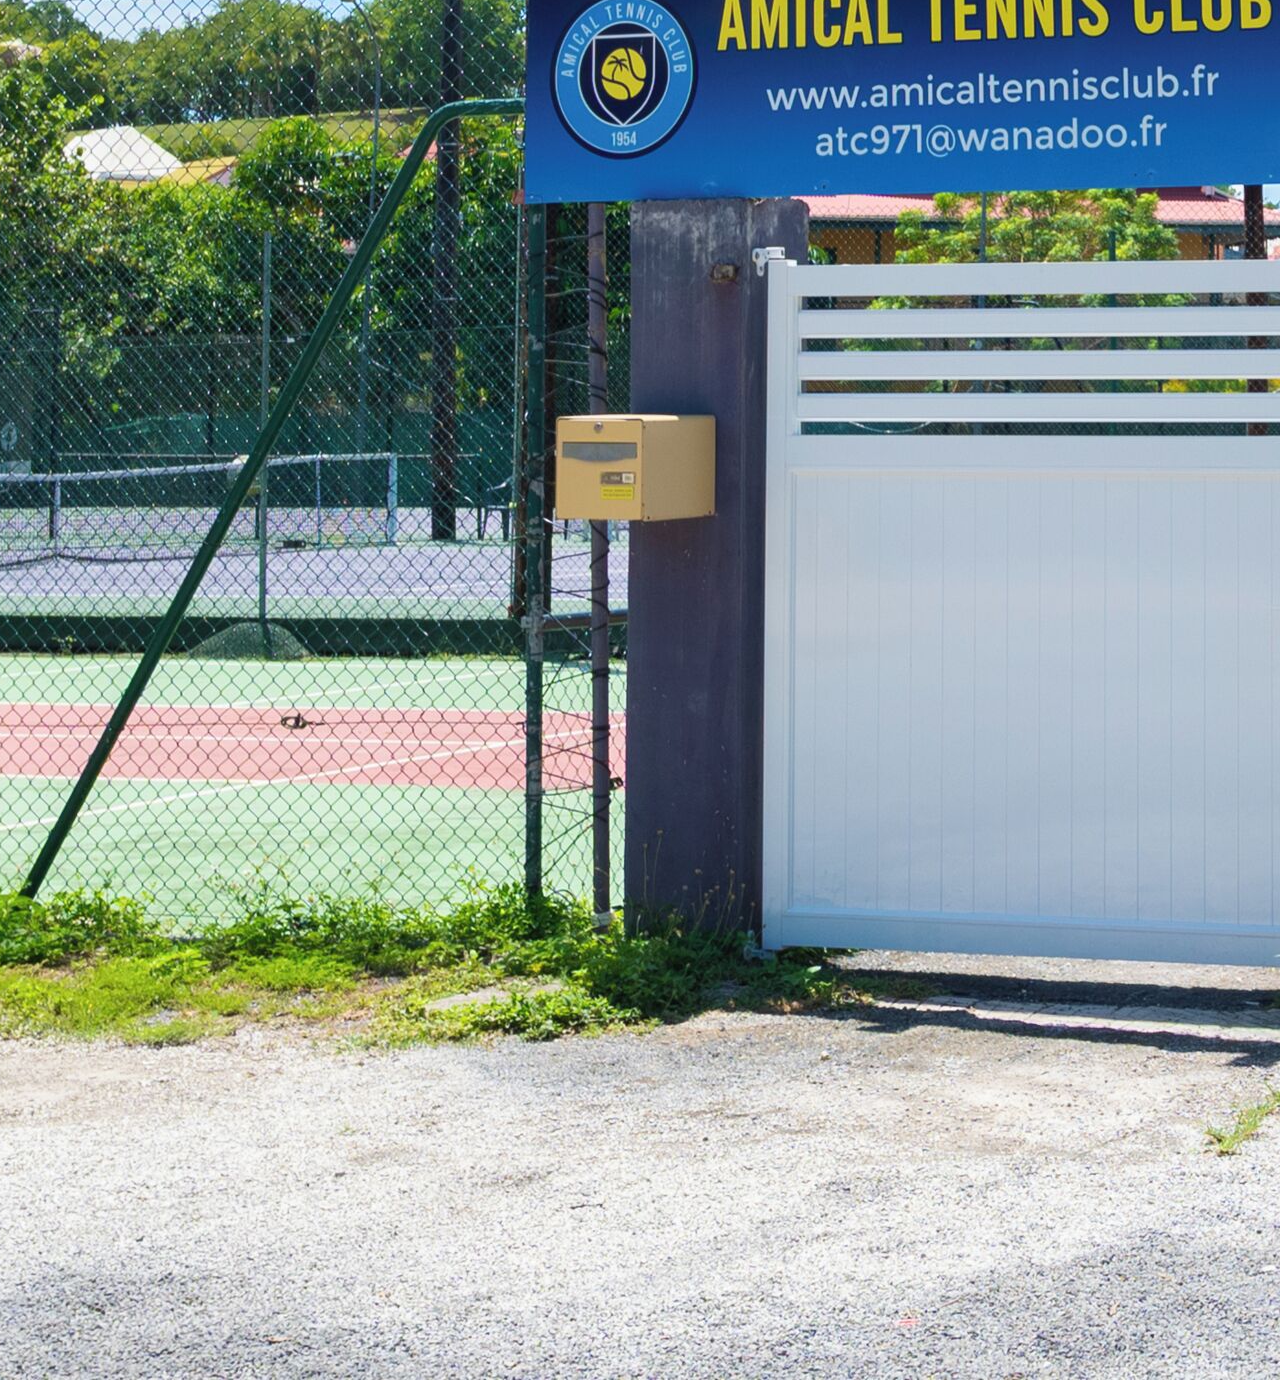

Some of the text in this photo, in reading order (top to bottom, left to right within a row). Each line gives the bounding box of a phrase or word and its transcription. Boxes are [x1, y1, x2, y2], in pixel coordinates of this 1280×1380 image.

[561, 2, 687, 78] AMICAL TENNIS CLUB
[766, 64, 1220, 112] www.amicaltennisclub.fr
[611, 131, 637, 147] 1954
[815, 114, 1168, 158] atc971@wanadoo.fr
